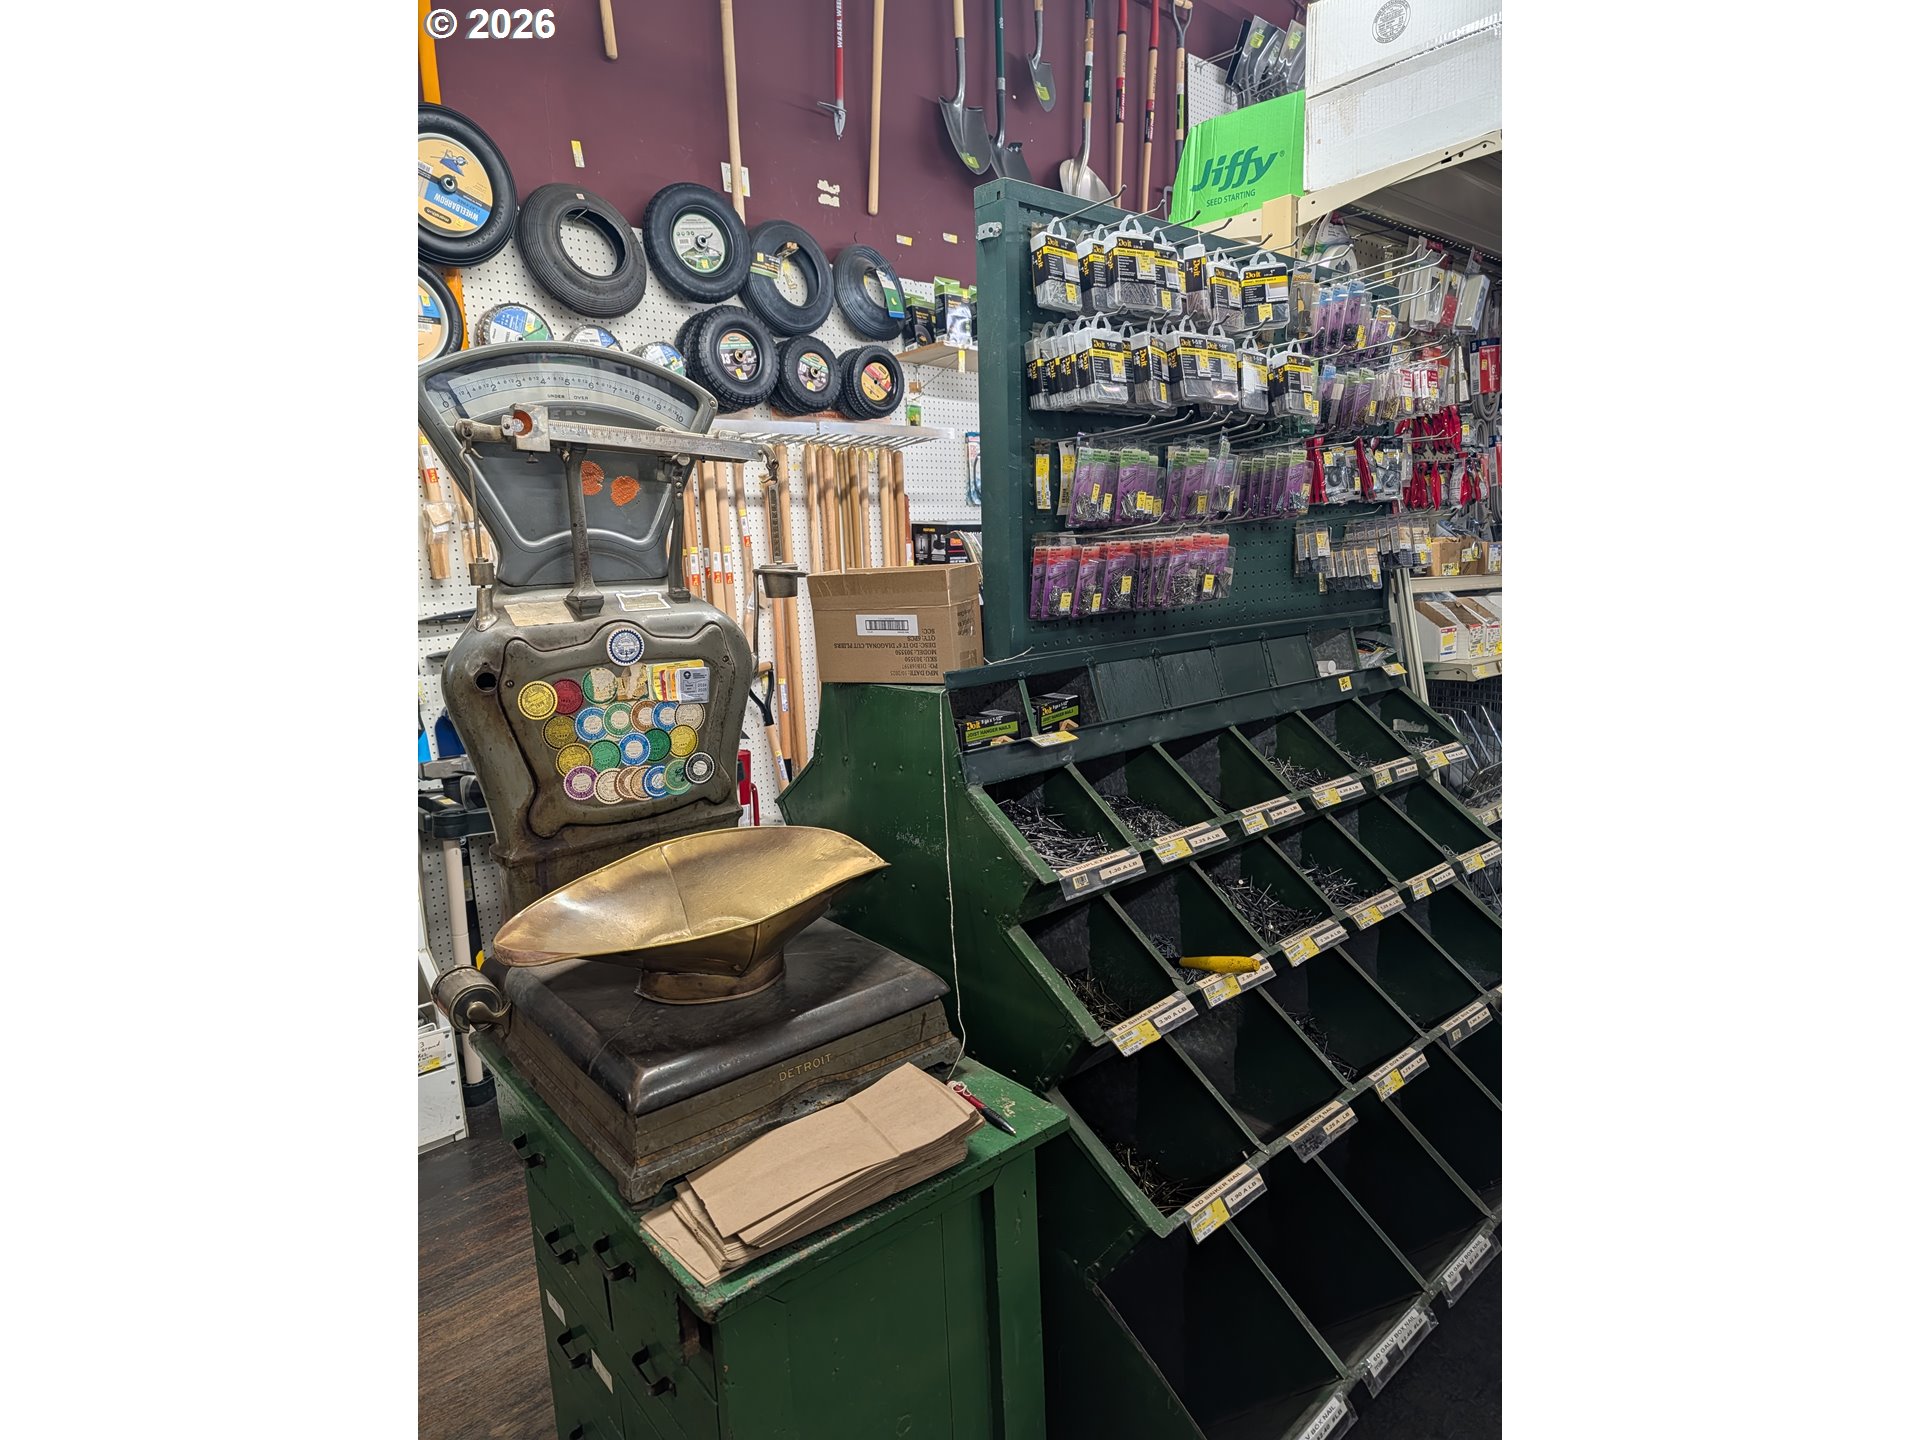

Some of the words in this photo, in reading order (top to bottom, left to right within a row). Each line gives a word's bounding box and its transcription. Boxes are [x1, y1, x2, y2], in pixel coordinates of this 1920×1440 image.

[1189, 145, 1278, 192] Jiffy
[433, 192, 479, 222] WHEELBARROW
[1206, 194, 1223, 207] SEED
[1224, 188, 1256, 204] STARTING
[634, 394, 640, 402] 8
[676, 414, 684, 422] 10
[966, 720, 981, 731] Doit
[981, 728, 998, 736] HANGER
[1169, 830, 1188, 839] FINISH
[1076, 858, 1103, 870] DUPLEX
[1293, 928, 1315, 941] COMMON
[1128, 1010, 1152, 1025] SINKER
[1153, 1001, 1167, 1010] NAIL
[778, 1053, 832, 1082] DETROIT
[1300, 1122, 1311, 1132] BRT
[1311, 1115, 1322, 1123] BOX
[1322, 1107, 1334, 1116] NAIL
[1204, 1182, 1227, 1200] SINKER
[1228, 1171, 1243, 1182] NAIL
[1248, 1181, 1257, 1189] LB
[1464, 1250, 1474, 1260] BOX
[1473, 1240, 1482, 1250] NAIL
[1380, 1338, 1394, 1353] GALV
[1394, 1327, 1405, 1338] BOX
[1404, 1316, 1416, 1327] NAIL
[1311, 1419, 1323, 1435] BOX
[1322, 1406, 1336, 1420] NAIL
